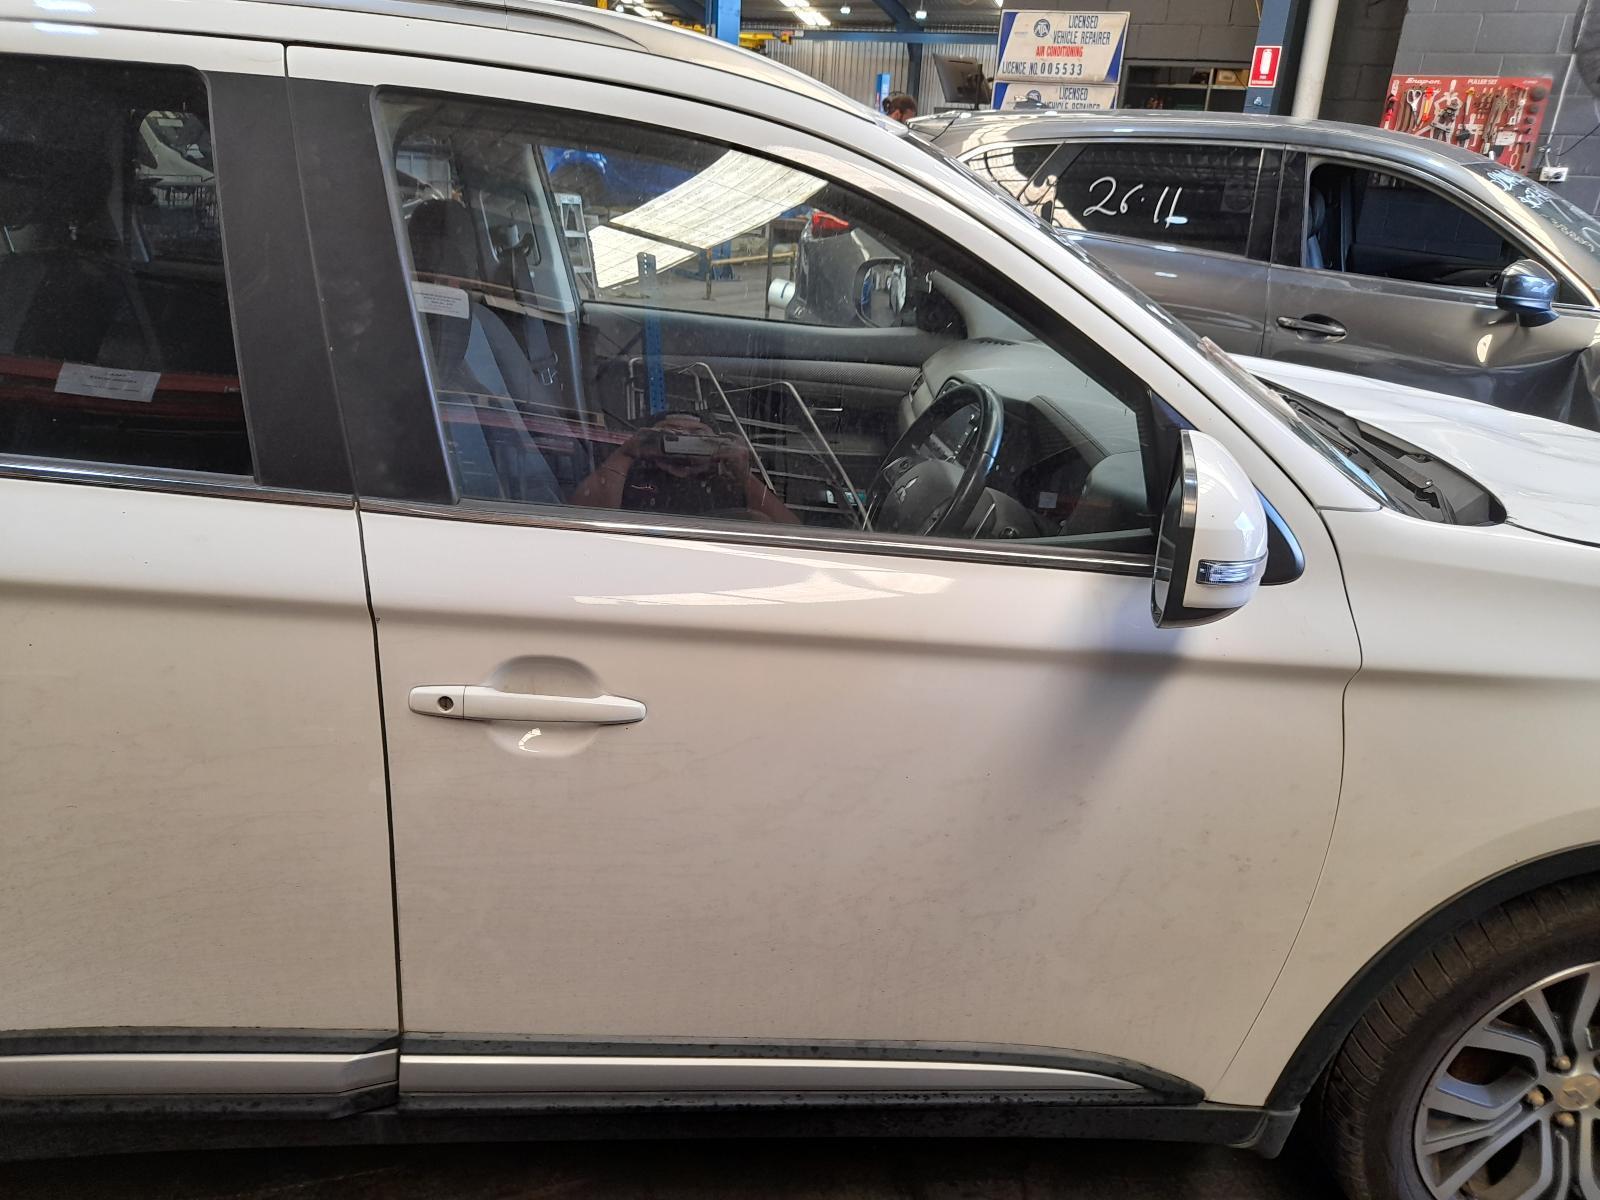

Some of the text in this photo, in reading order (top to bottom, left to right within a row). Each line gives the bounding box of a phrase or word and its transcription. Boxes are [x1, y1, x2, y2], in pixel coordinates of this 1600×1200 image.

[1068, 15, 1099, 29] LICENSED
[1053, 30, 1111, 46] VEHICLE REPAIRER
[1036, 46, 1084, 58] AIR CONDITIONING
[1002, 61, 1026, 75] LICENCE
[1405, 77, 1441, 86] Snap-on
[1058, 87, 1089, 101] LICENSED
